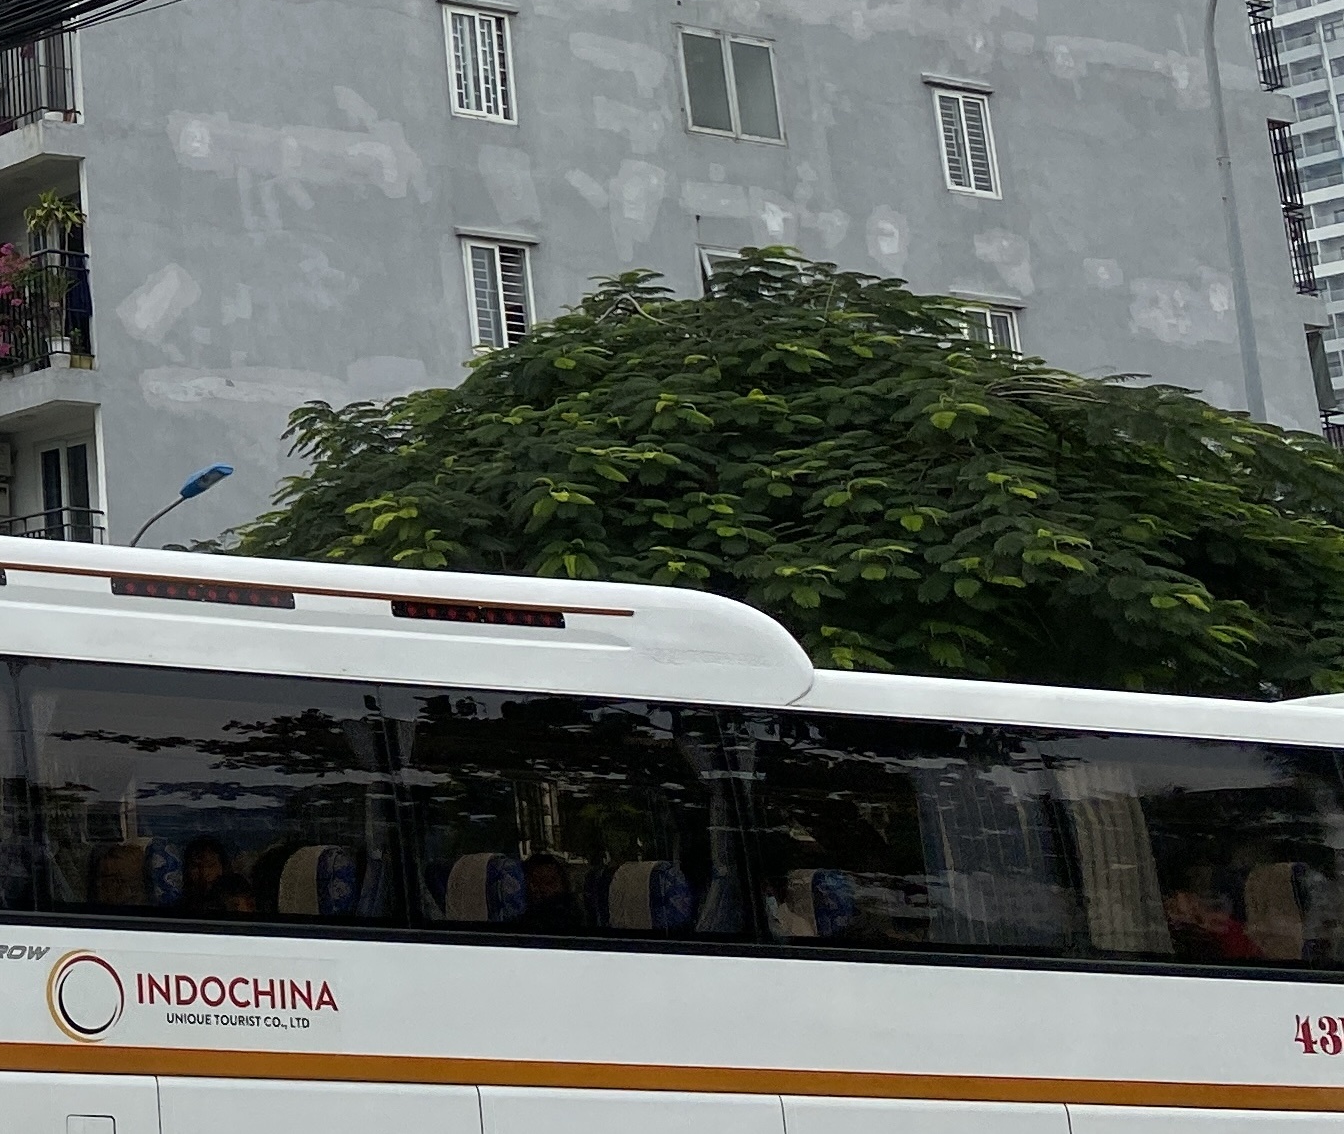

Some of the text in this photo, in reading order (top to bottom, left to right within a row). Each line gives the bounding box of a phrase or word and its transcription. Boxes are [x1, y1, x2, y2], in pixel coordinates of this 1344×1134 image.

[136, 972, 339, 1012] INDOCHINA
[166, 1012, 212, 1026] UNIQUE
[215, 1014, 261, 1028] TOURIST
[290, 1017, 310, 1029] LTD
[1294, 1014, 1344, 1056] 43
